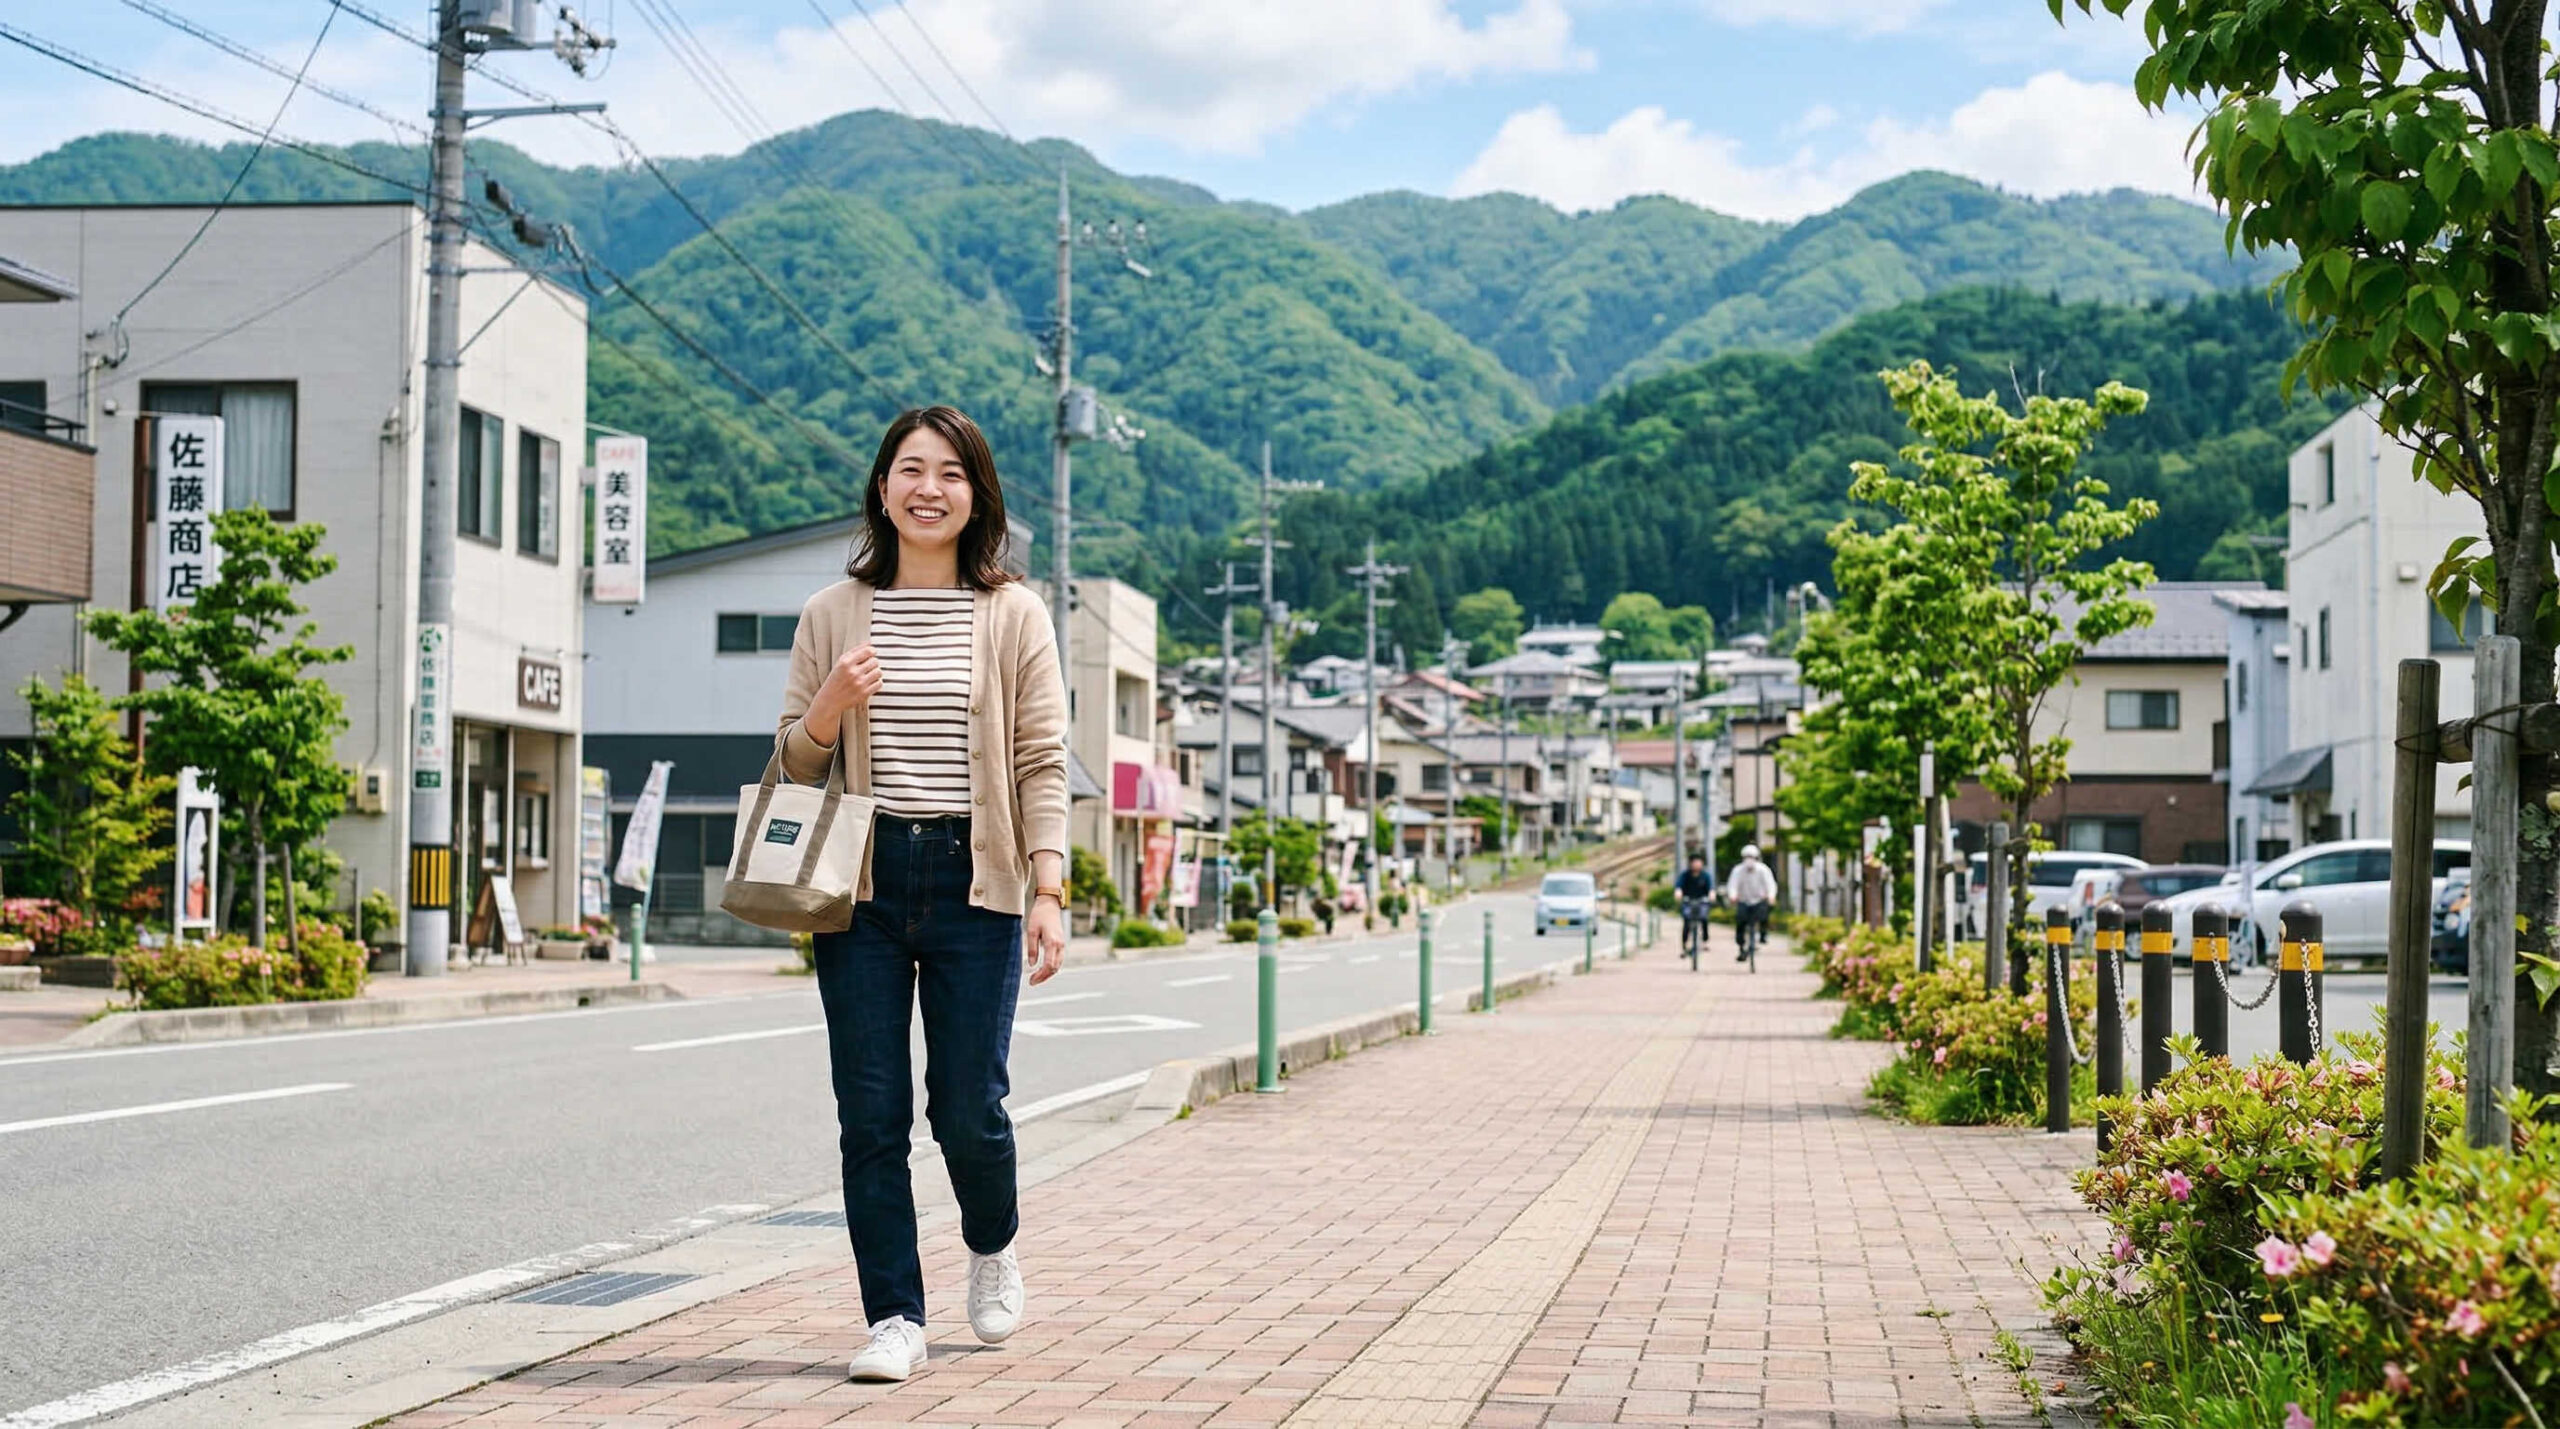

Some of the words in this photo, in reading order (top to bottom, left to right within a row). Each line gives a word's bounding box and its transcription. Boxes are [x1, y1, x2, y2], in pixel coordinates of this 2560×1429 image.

[167, 432, 205, 599] 佐藤商店
[604, 470, 631, 565] 美容室
[524, 664, 559, 704] CAFE
